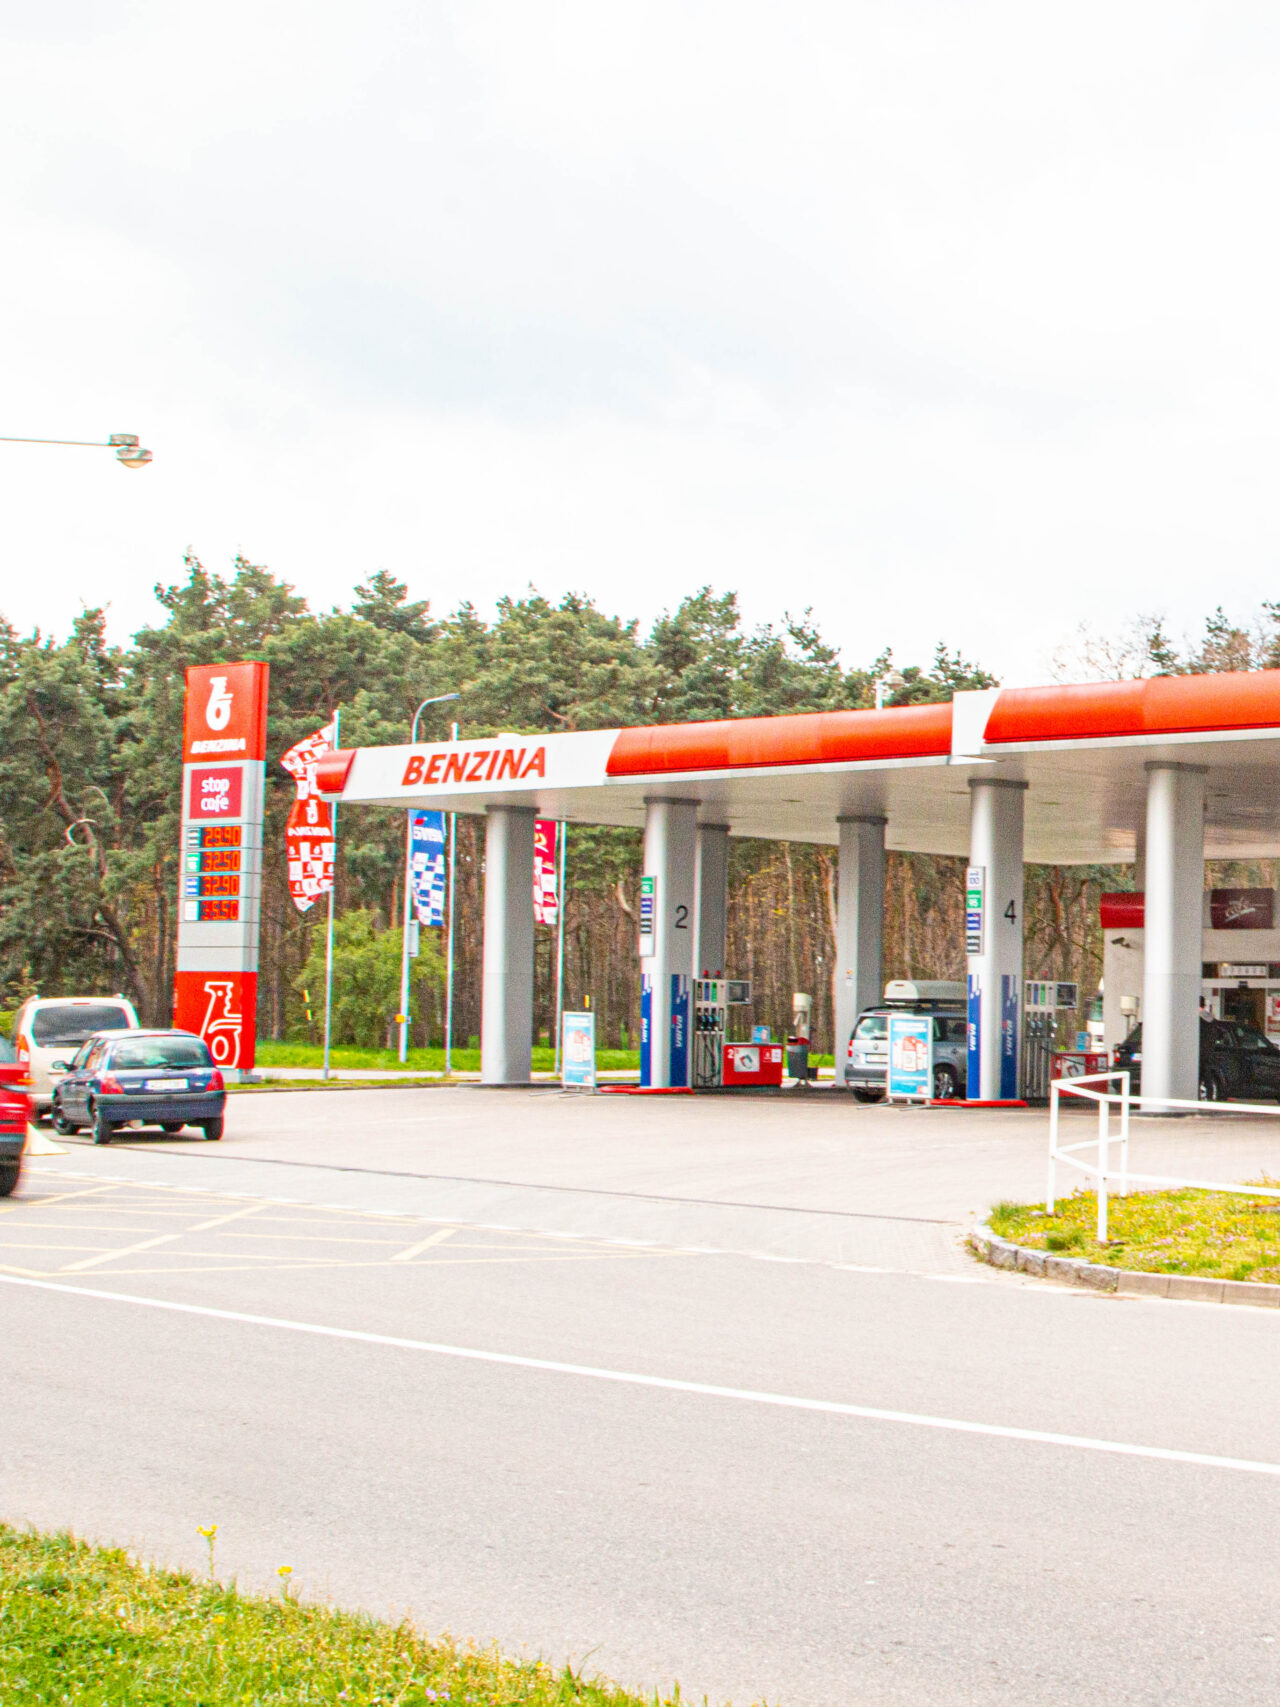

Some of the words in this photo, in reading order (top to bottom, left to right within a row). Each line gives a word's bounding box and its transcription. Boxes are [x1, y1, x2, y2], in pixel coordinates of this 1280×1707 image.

[401, 746, 546, 786] BENZINA
[201, 777, 231, 796] stop
[200, 795, 230, 812] cafe
[674, 905, 689, 929] 2
[1003, 899, 1017, 925] 4
